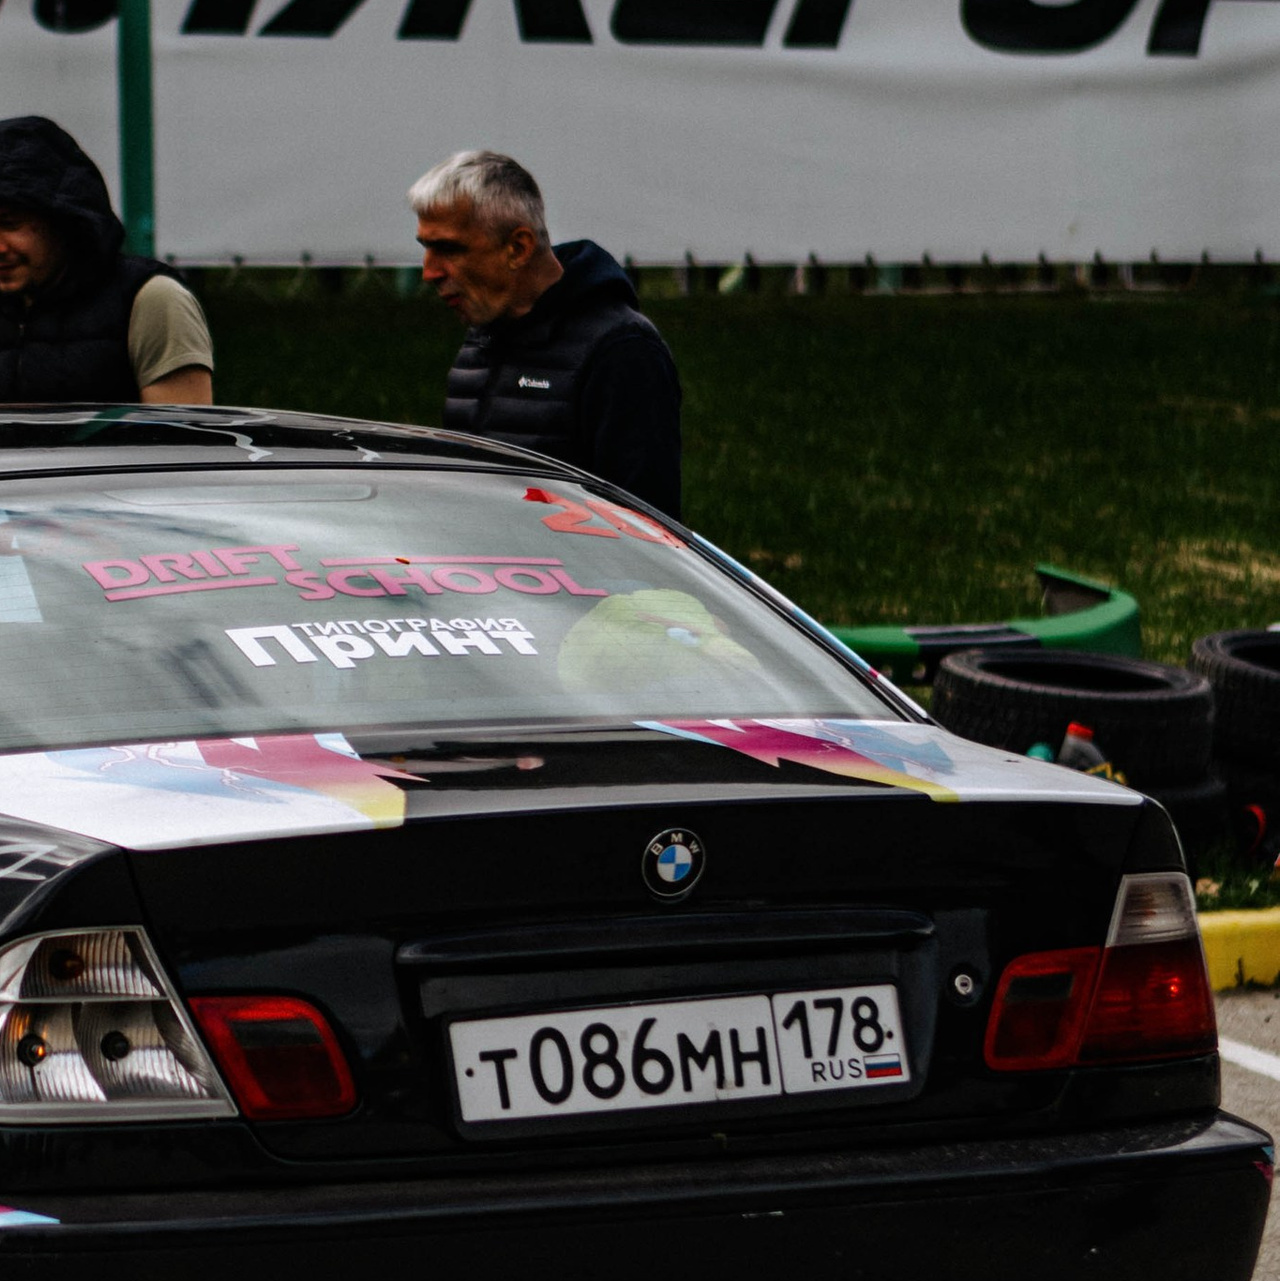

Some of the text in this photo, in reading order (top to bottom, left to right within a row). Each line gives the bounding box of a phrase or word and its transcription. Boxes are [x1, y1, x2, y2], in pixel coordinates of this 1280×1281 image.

[83, 544, 306, 591] DRIFT
[284, 566, 609, 601] SCHOOL
[291, 618, 526, 636] ТИПОГРАФИЯ
[225, 625, 539, 669] Принт
[650, 832, 701, 856] BMW
[478, 996, 885, 1111] Т086МН 178
[811, 1056, 864, 1083] RUS
